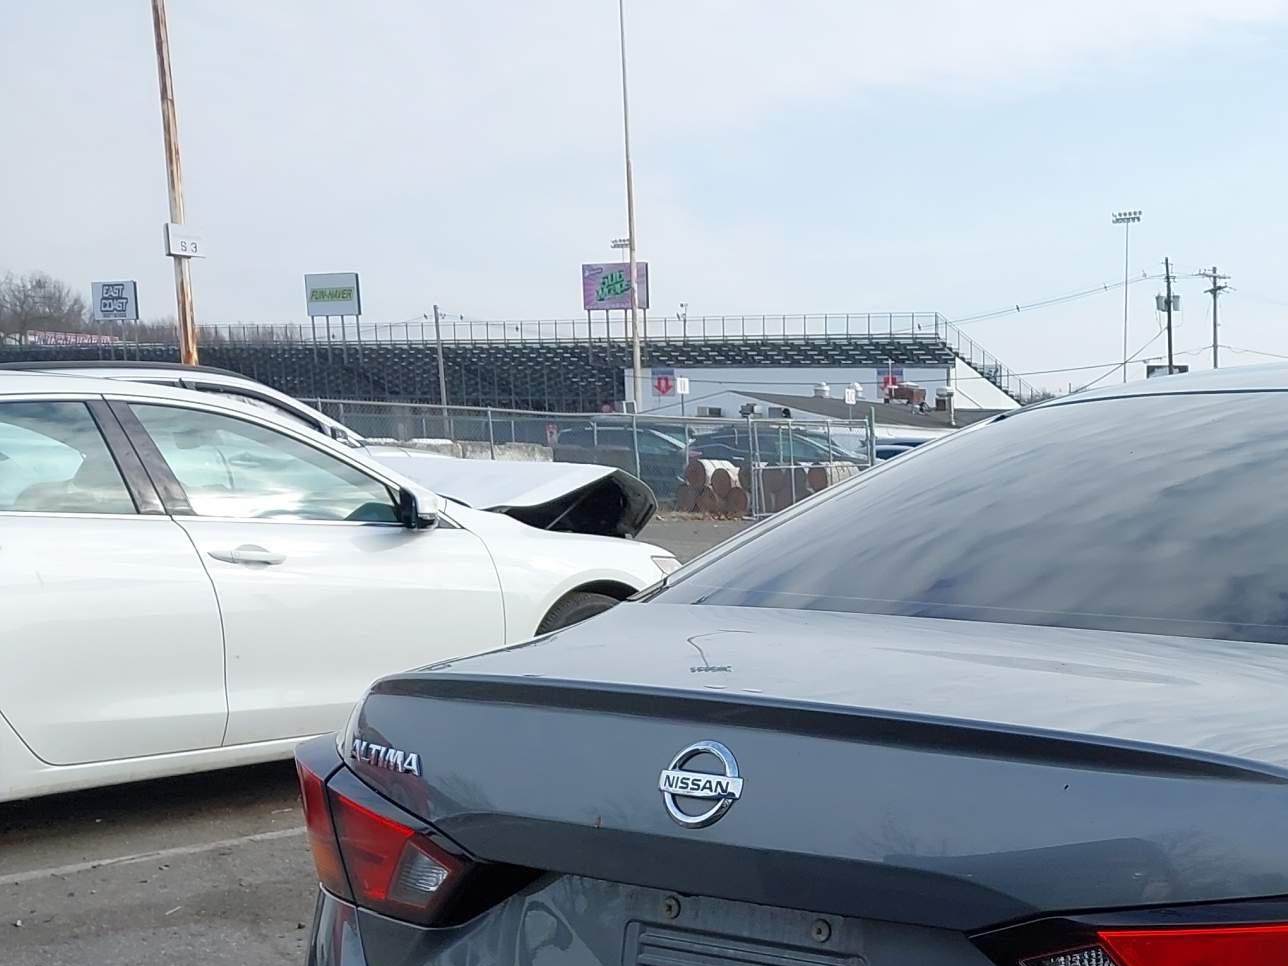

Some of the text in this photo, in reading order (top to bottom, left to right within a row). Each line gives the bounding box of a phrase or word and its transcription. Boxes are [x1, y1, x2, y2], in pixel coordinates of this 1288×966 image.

[102, 284, 124, 297] EAST
[101, 297, 128, 312] COAST
[352, 739, 421, 776] ALTIMA
[663, 774, 730, 793] NISSAN
